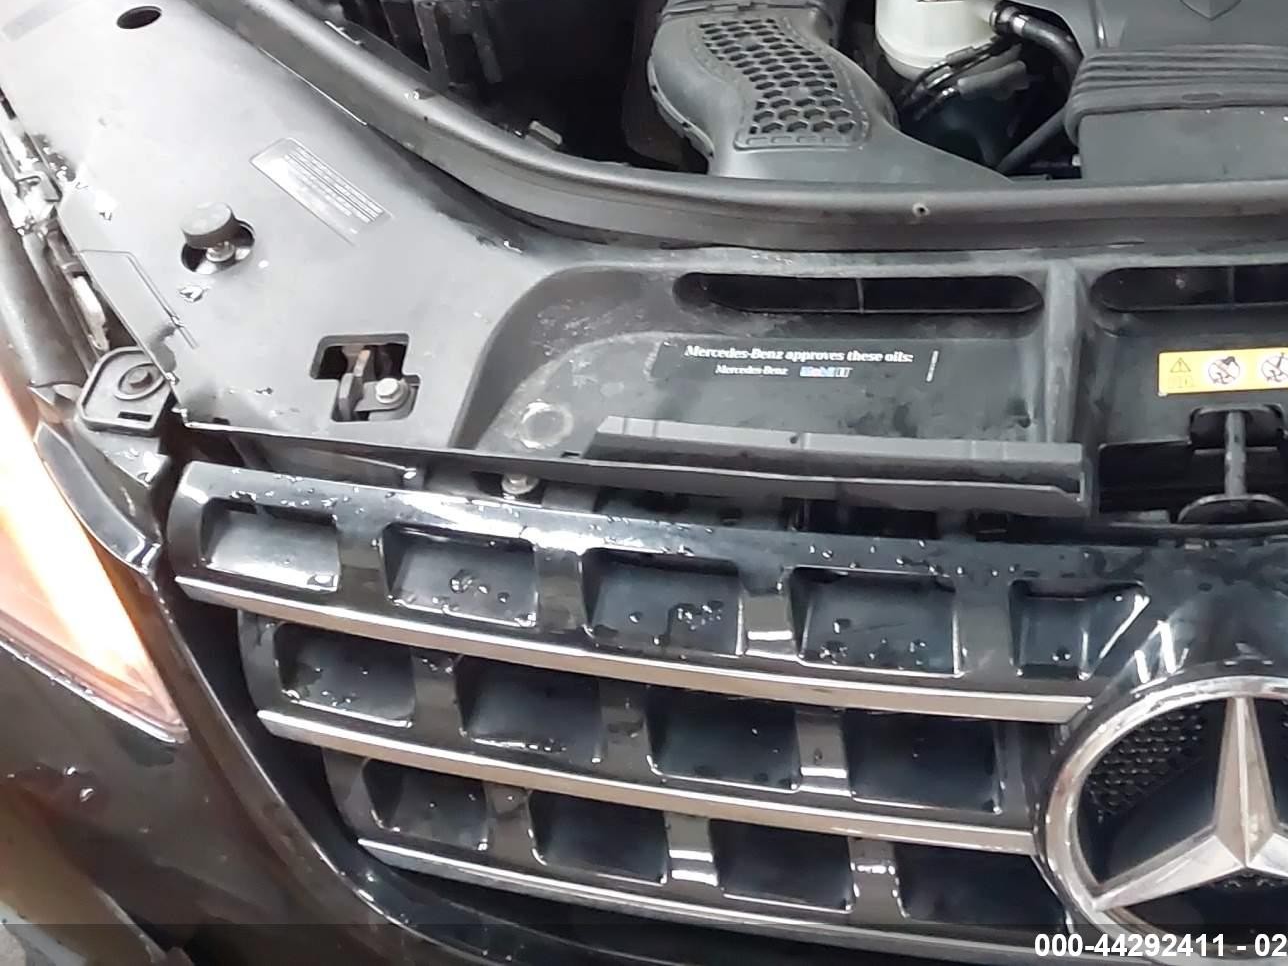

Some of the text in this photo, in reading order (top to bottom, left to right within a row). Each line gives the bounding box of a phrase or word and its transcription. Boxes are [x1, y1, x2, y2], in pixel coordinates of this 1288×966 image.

[684, 345, 914, 363] Mercedes-Benz approves these oils:
